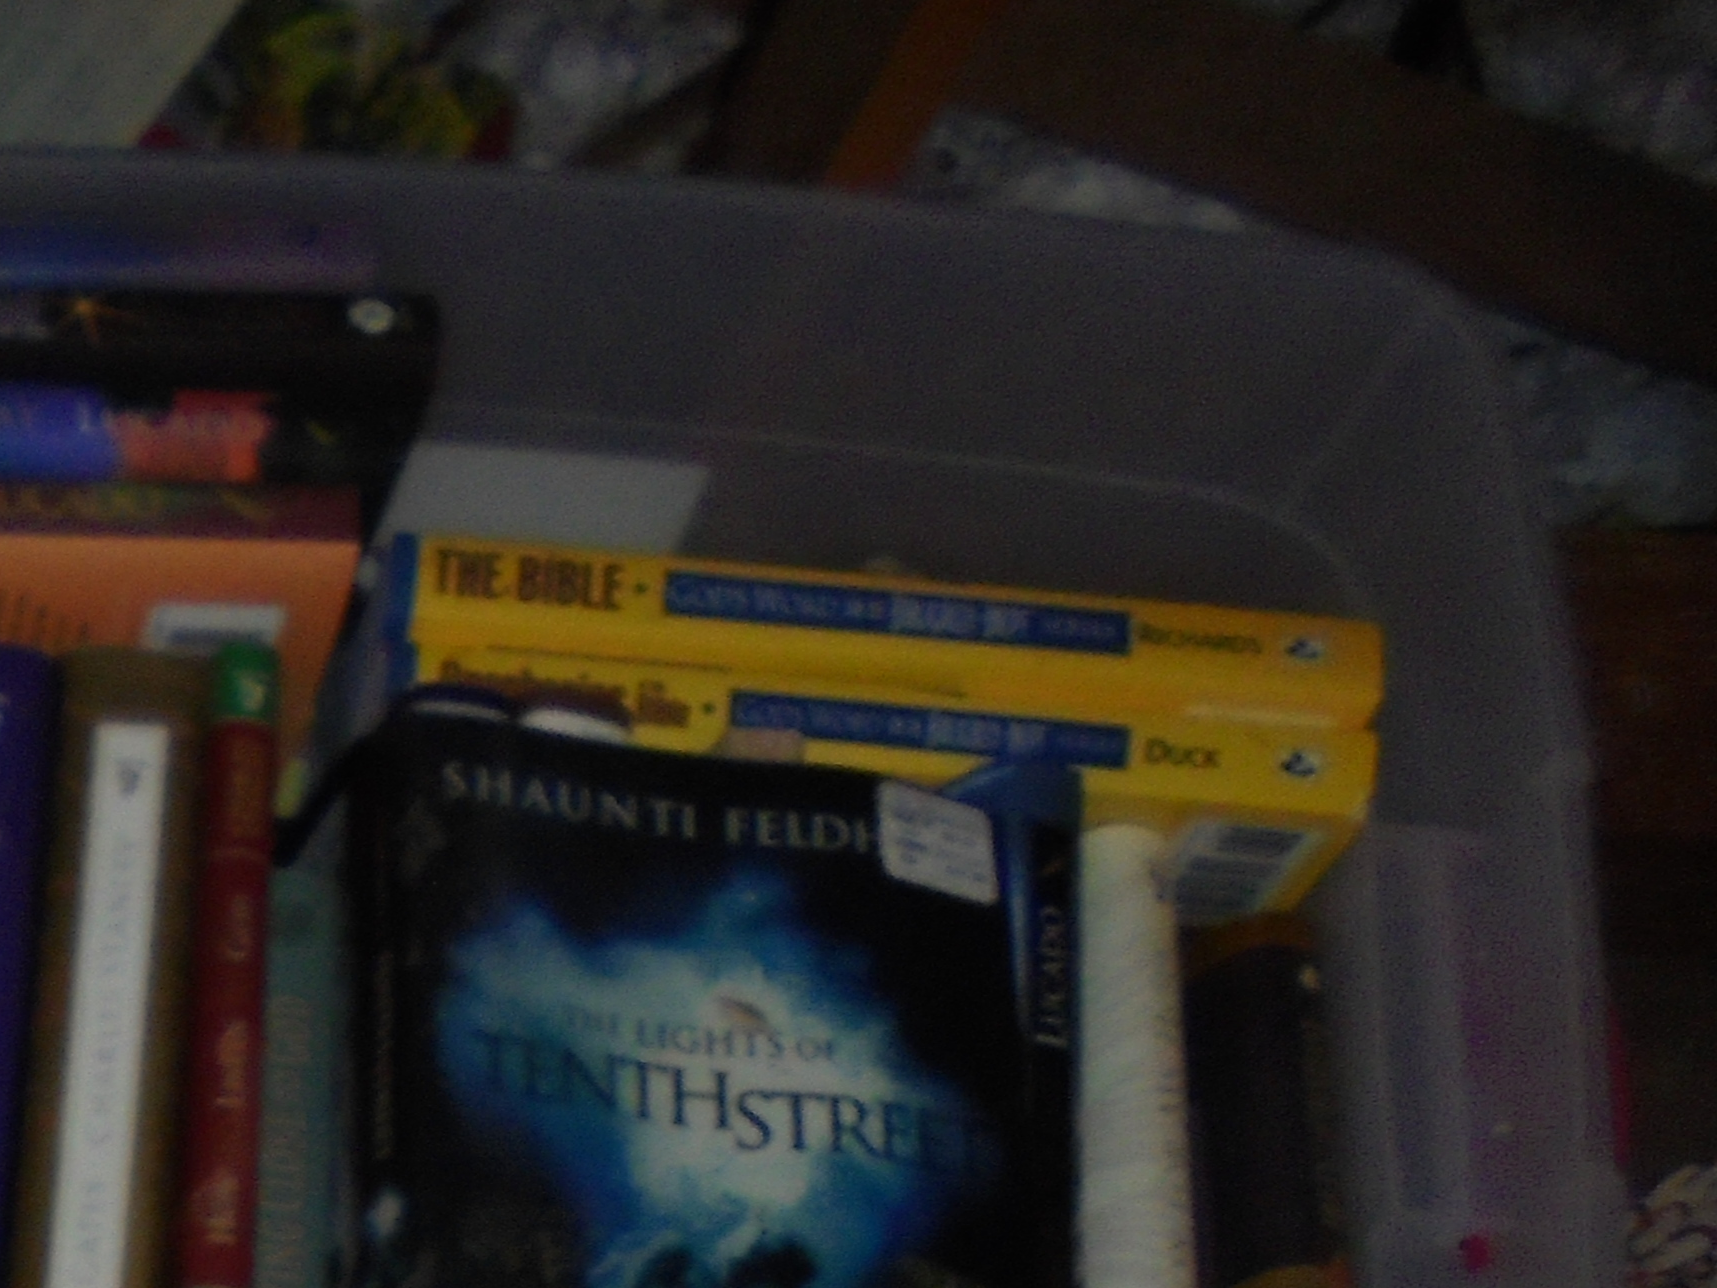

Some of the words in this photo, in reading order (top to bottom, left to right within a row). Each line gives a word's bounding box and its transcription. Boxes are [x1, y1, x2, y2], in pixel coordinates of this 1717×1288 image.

[436, 549, 502, 599] THE
[516, 558, 623, 608] BIBLE
[1143, 737, 1220, 769] DUCK
[440, 760, 699, 841] SHAUNTI
[1033, 905, 1068, 1048] LUCADO
[268, 991, 312, 1069] GOD
[633, 1011, 784, 1067] LIGHTS
[462, 1024, 739, 1138] TENTH
